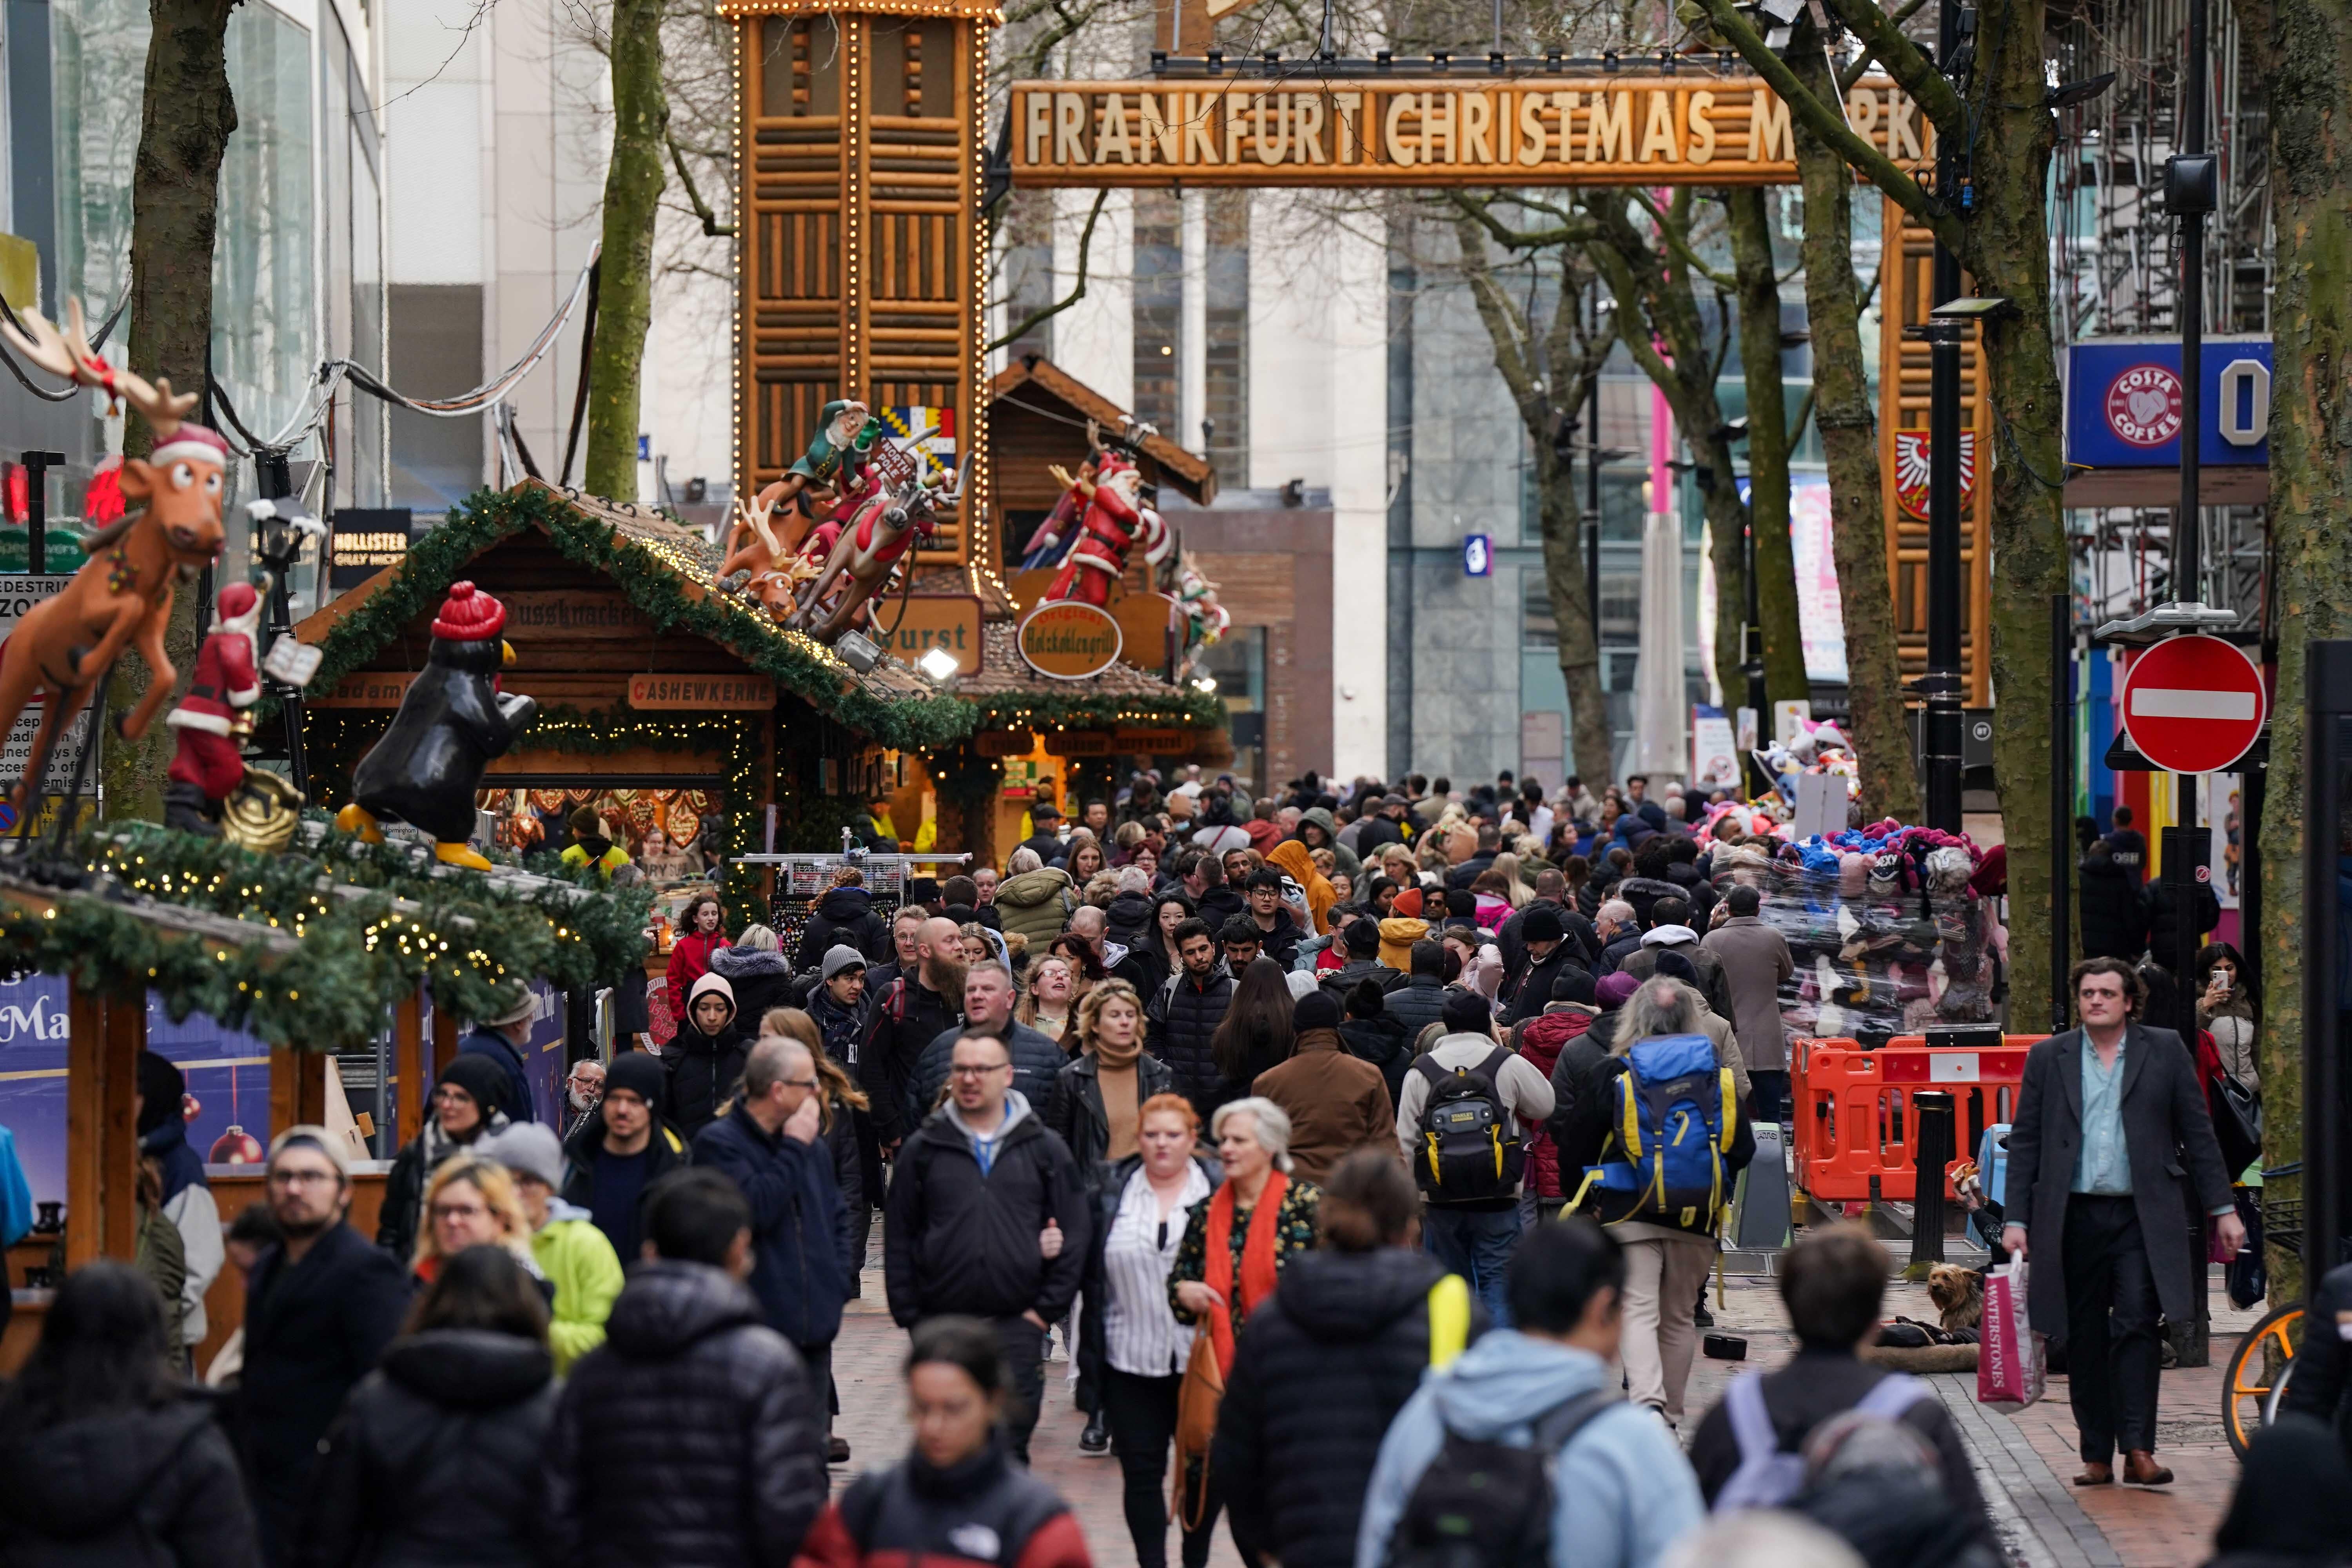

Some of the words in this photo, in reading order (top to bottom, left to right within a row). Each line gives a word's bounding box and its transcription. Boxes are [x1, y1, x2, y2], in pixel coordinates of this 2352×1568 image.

[1027, 92, 1361, 165] FRANKFURT
[1385, 91, 1715, 166] CHRISTMAS
[1748, 88, 1937, 162] MRK
[2119, 370, 2173, 394] COSTA
[2115, 413, 2180, 440] COFFEE
[877, 453, 900, 478] POLE
[882, 442, 911, 475] NORTH
[334, 532, 407, 550] HOLLISTER
[0, 598, 41, 617] ZO
[1038, 608, 1104, 625] Original
[634, 682, 770, 701] CASHEWKERNE
[388, 826, 416, 835] birmingham
[1987, 1284, 2004, 1388] WATERSTONES
